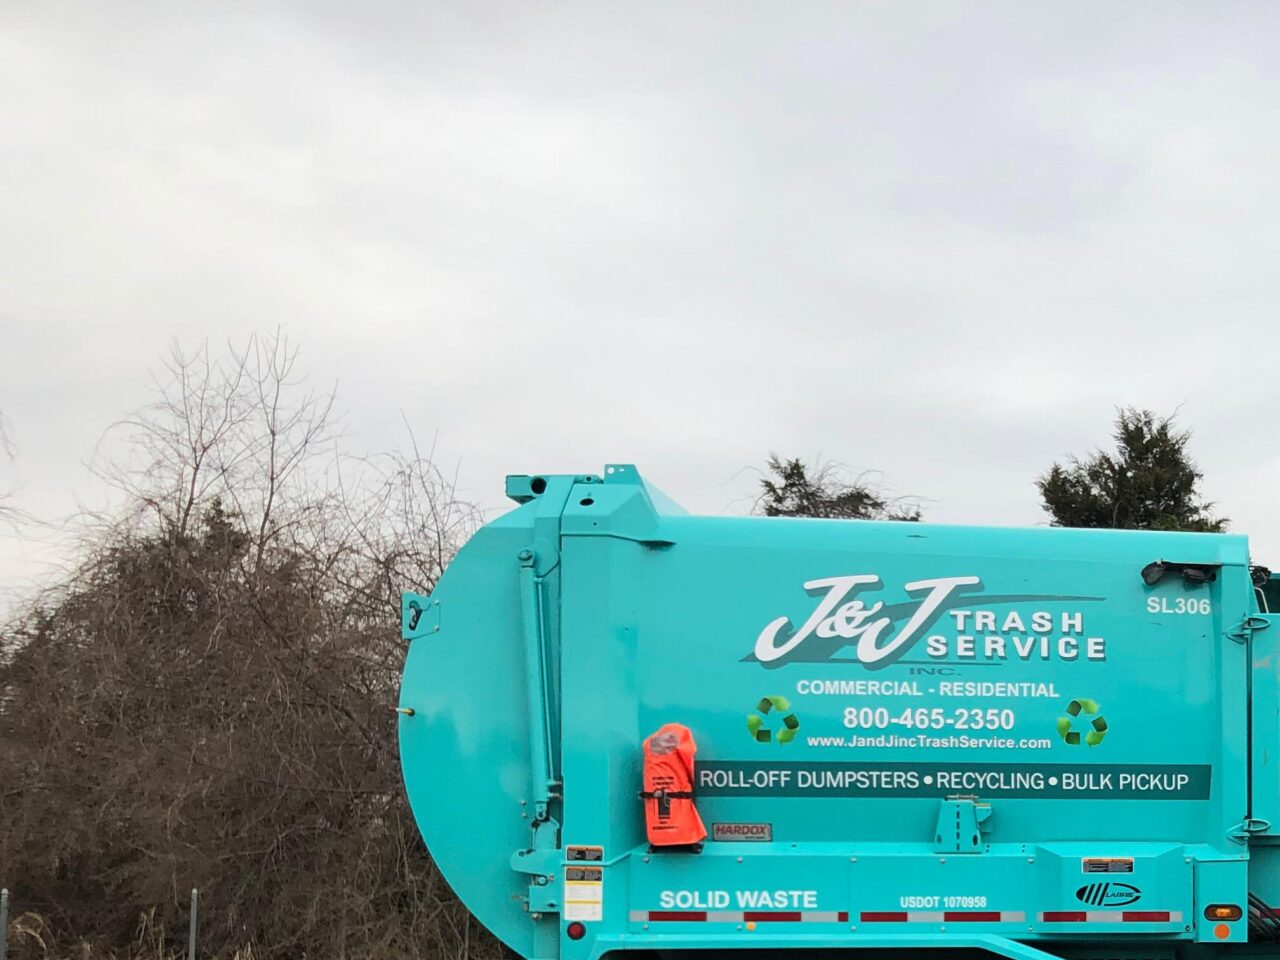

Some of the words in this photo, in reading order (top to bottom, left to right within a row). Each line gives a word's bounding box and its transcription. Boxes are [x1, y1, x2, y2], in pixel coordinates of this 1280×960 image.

[1146, 597, 1211, 615] SL306
[754, 574, 981, 664] J&J
[950, 610, 1084, 633] TRASH
[926, 635, 1106, 659] SERVICE
[908, 667, 962, 677] INC.
[797, 680, 923, 696] COMMERCIAL
[939, 681, 1060, 698] RESIDENTIAL
[843, 707, 1015, 731] 800-465-2350
[807, 734, 1052, 749] www.JandJincTrashService.com
[700, 769, 792, 788] ROLL-OFF
[798, 771, 920, 789] DUMPSTERS
[936, 772, 1045, 789] RECYCLING
[1062, 773, 1113, 790] BULK
[1119, 773, 1189, 791] PICKUP
[716, 825, 767, 835] HARDOX
[659, 890, 731, 908] SOLID
[736, 890, 818, 908] WASTE
[900, 895, 940, 909] USDOT
[943, 895, 988, 909] 1070958
